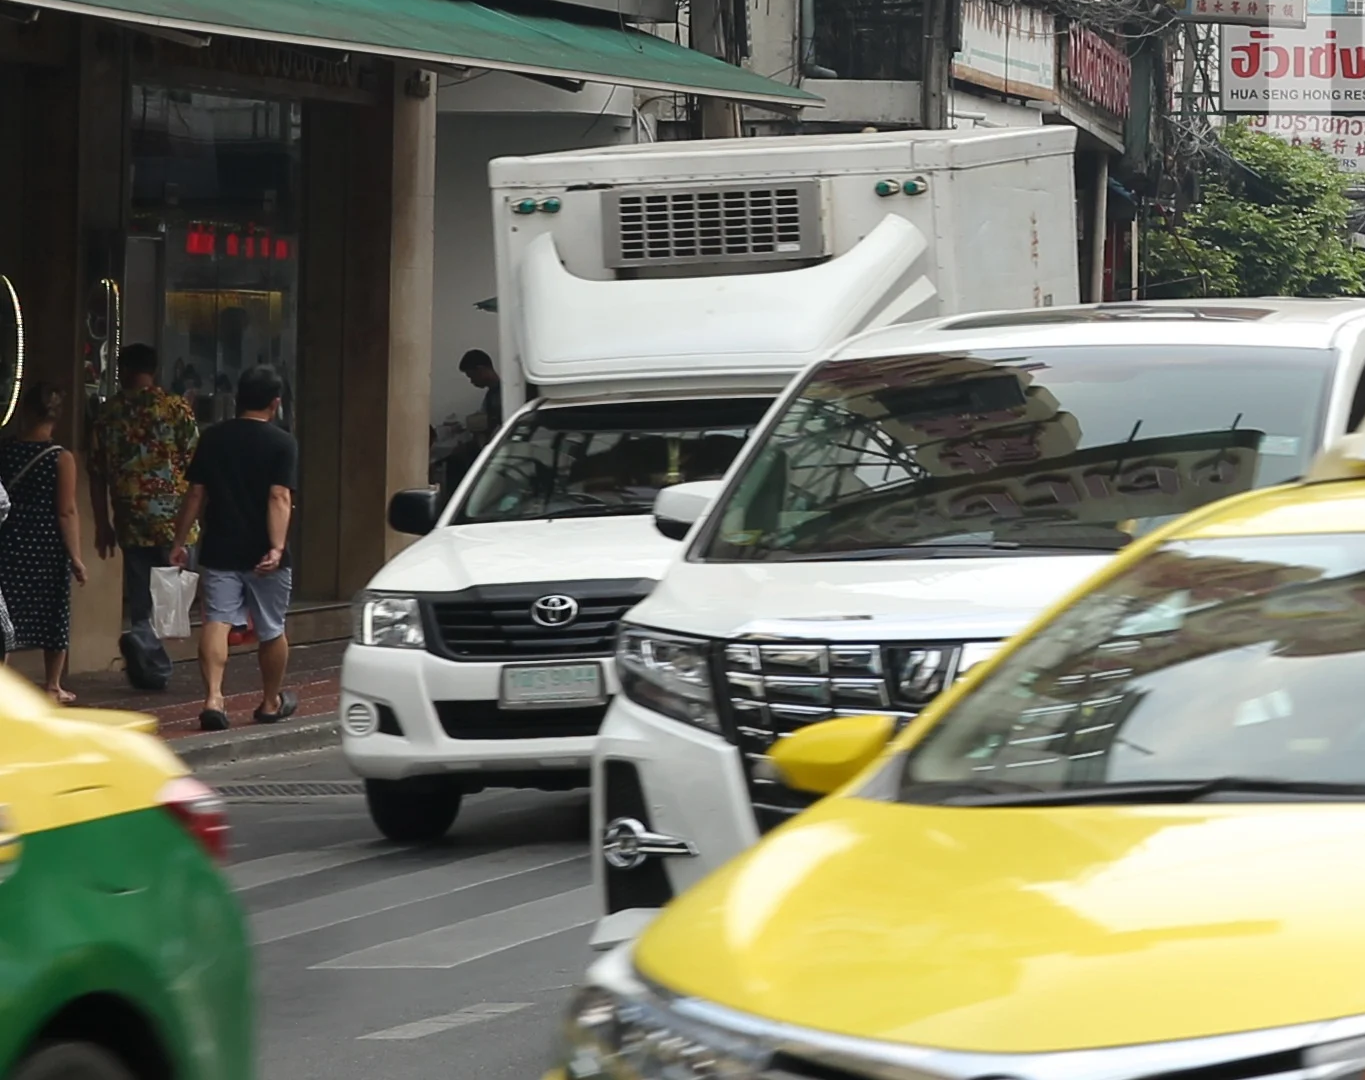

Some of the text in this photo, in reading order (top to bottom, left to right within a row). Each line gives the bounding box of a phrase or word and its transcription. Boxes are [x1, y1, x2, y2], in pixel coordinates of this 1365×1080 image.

[1230, 89, 1259, 101] HUA
[1263, 89, 1299, 101] SENG
[1302, 89, 1341, 101] HONG
